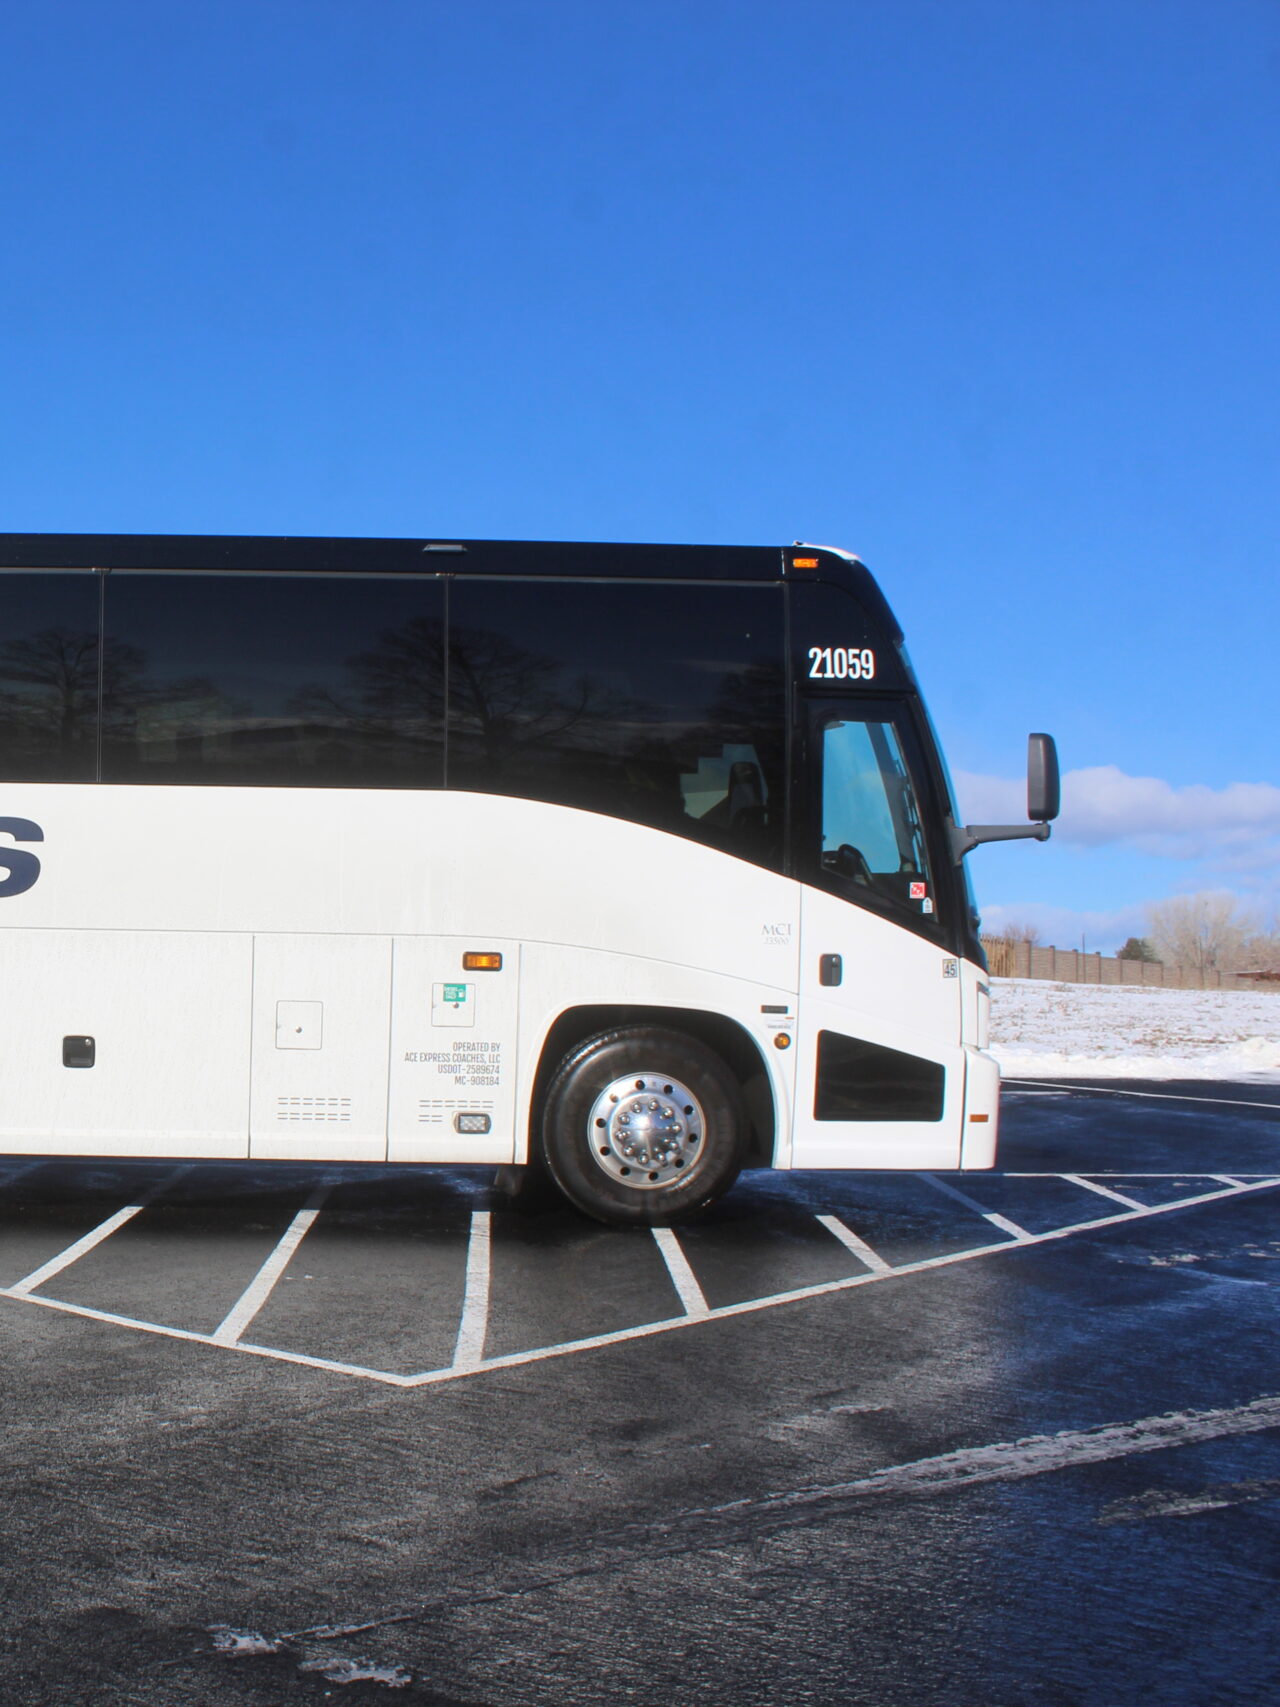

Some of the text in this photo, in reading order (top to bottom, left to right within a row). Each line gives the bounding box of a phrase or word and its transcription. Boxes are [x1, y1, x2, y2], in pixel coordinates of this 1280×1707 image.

[808, 646, 875, 679] 21059
[761, 923, 791, 935] MCI
[944, 963, 956, 977] 45
[452, 1041, 501, 1052] OPERATED BY
[404, 1052, 501, 1064] ACE EXPRESS COACHES, LLC
[438, 1064, 500, 1074] USDOT-2589674
[454, 1075, 500, 1086] MC-908184
